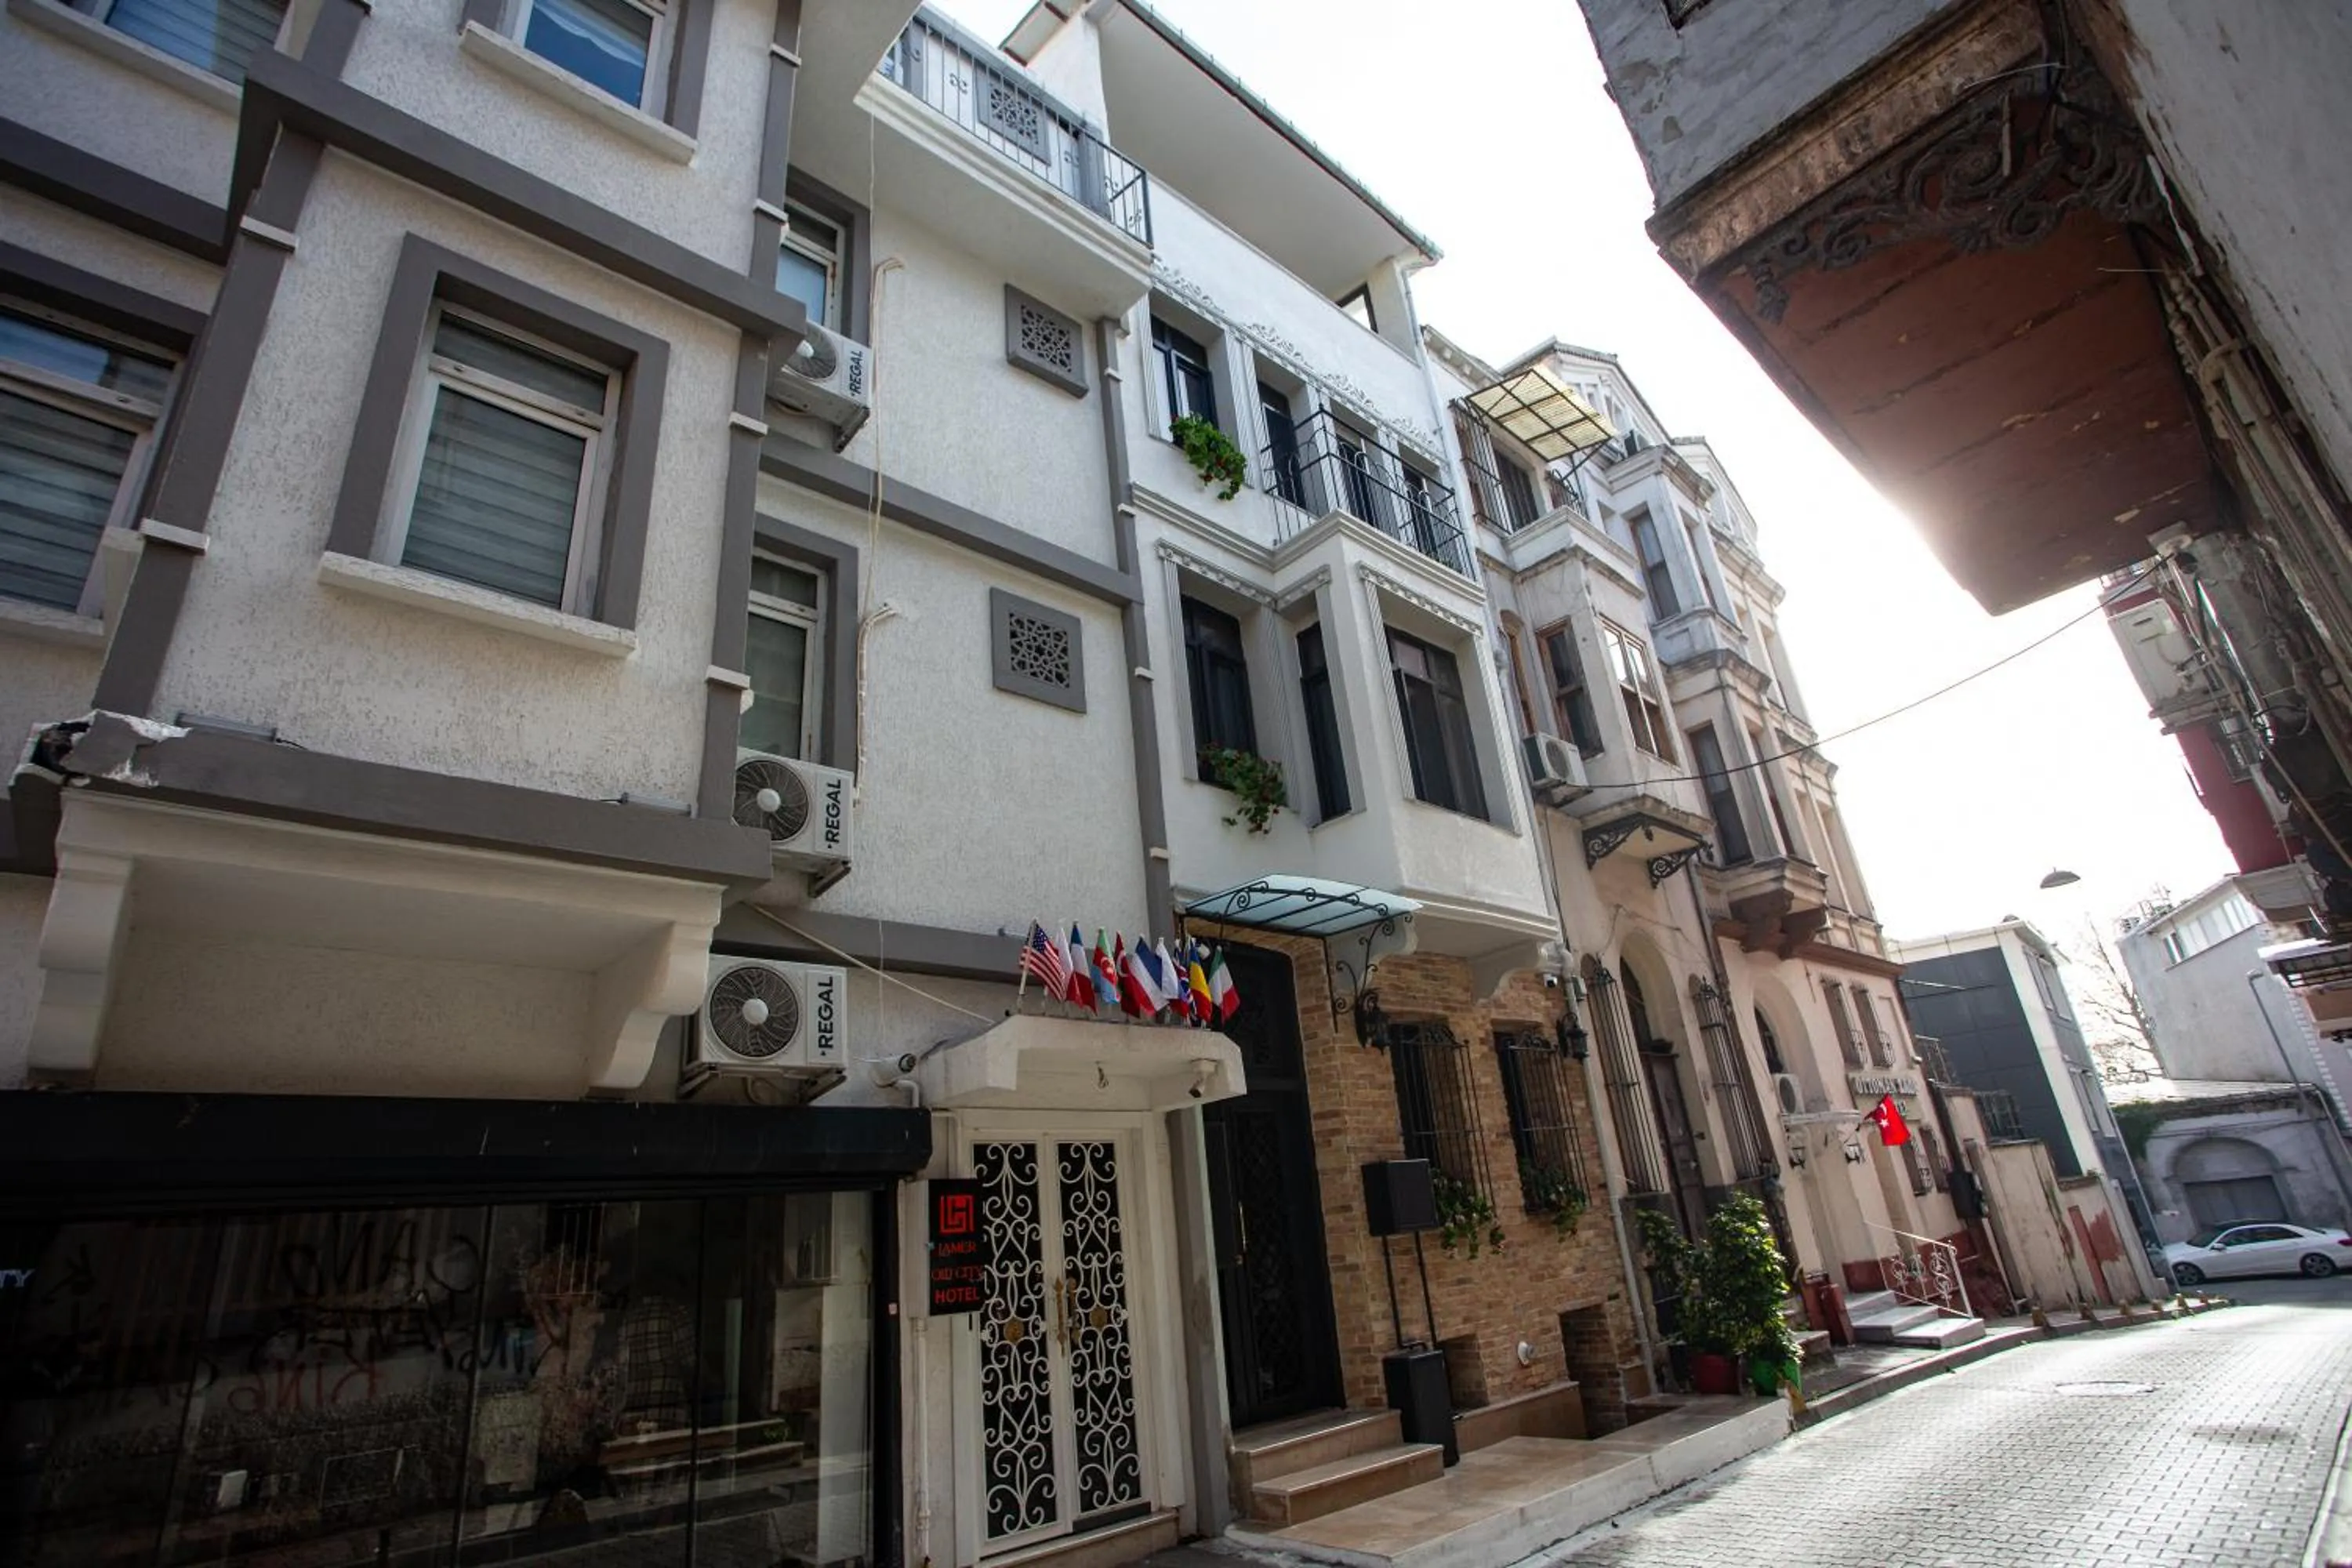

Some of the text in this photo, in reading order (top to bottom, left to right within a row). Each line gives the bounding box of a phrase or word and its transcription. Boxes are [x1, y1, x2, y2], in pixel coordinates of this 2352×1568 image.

[849, 350, 864, 395] REGAL
[826, 779, 841, 847] REGAL
[818, 976, 833, 1052] REGAL
[935, 1287, 980, 1305] HOTEL
